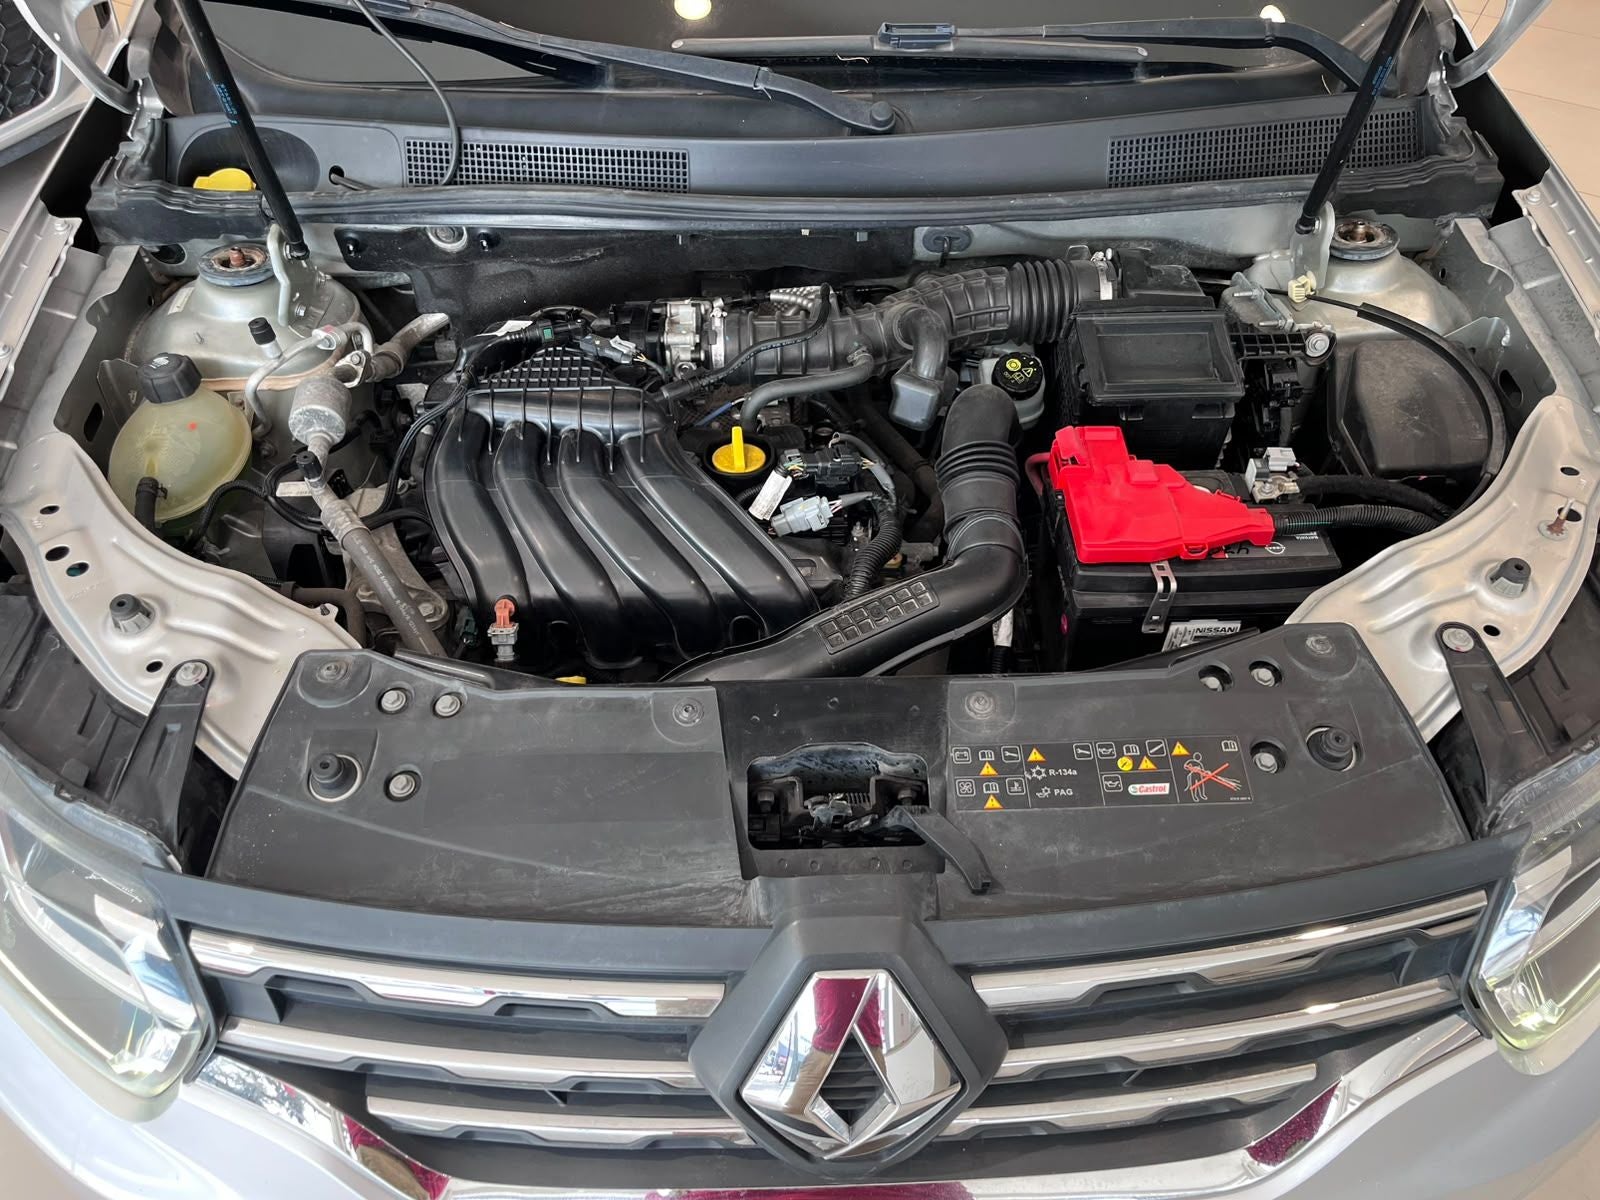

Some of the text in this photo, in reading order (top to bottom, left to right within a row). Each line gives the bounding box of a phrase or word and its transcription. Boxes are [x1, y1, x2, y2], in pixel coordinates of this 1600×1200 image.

[1048, 768, 1078, 776] R-134a
[1054, 788, 1073, 796] PAG
[1138, 785, 1167, 793] Castrol
